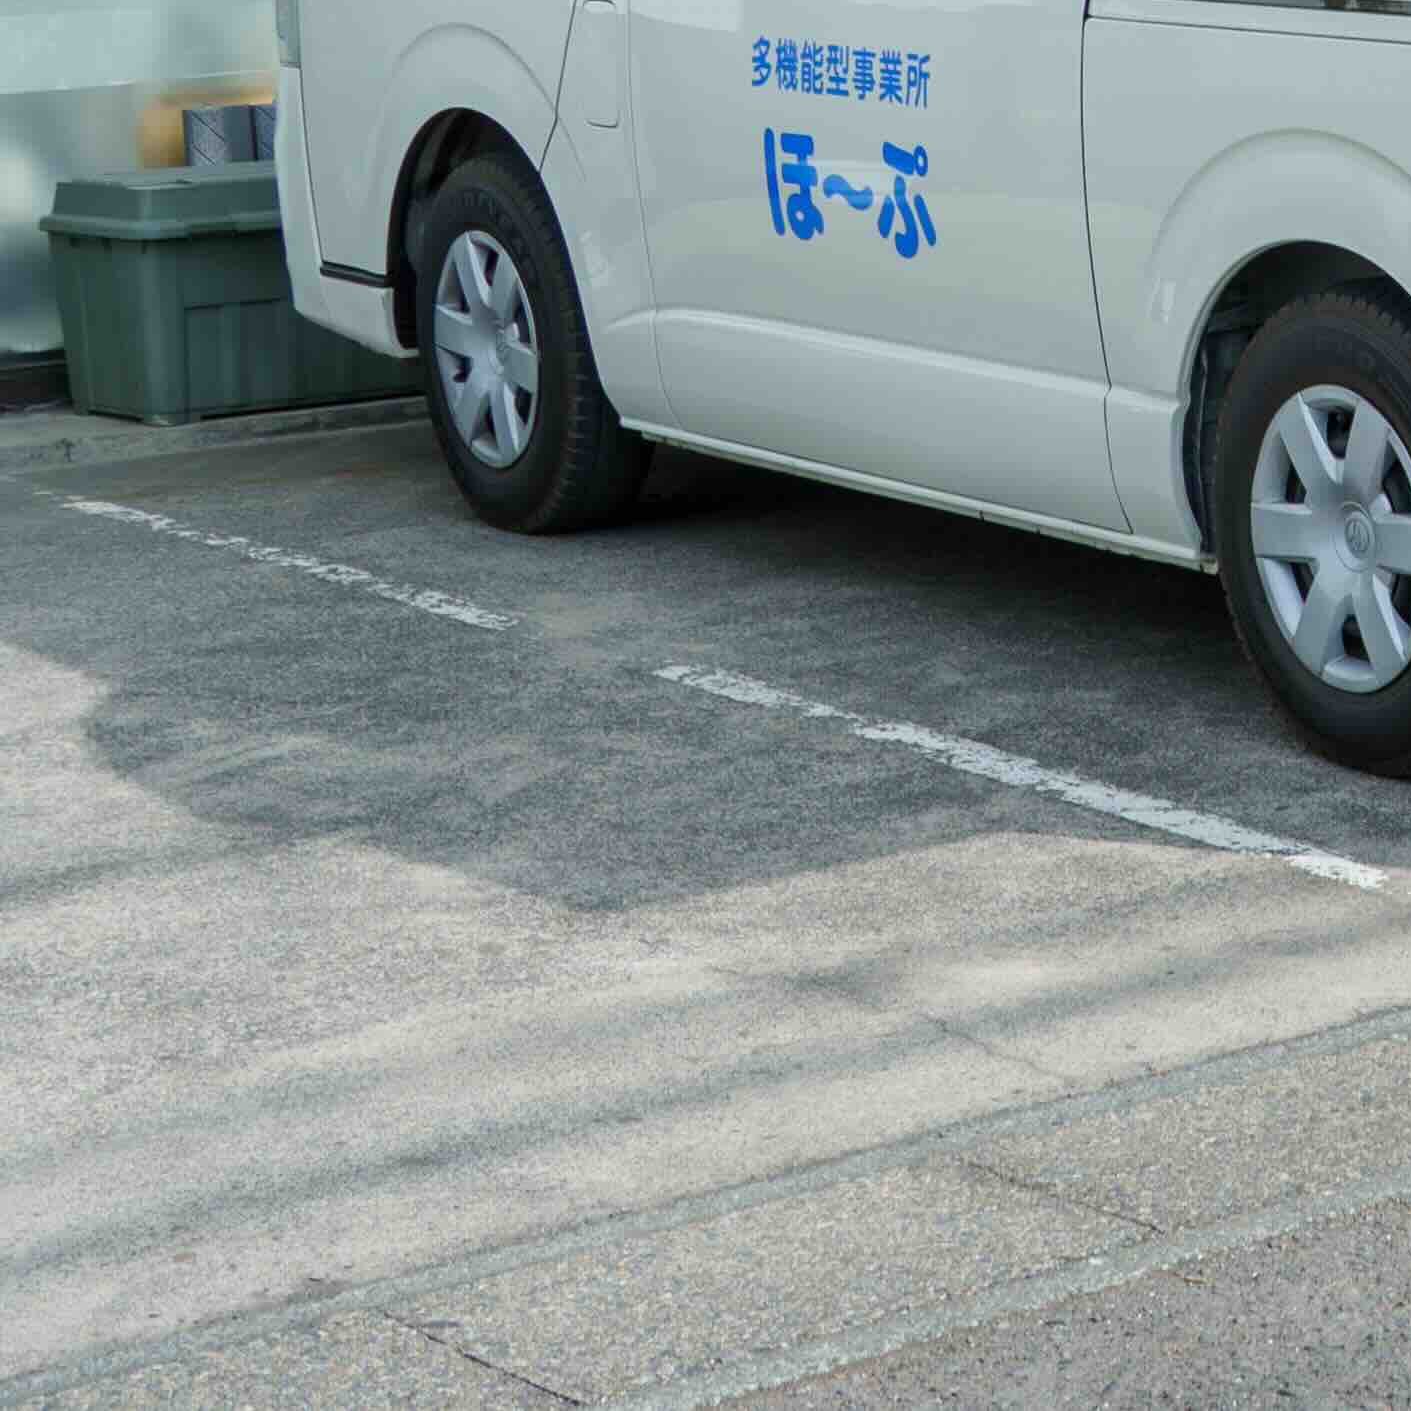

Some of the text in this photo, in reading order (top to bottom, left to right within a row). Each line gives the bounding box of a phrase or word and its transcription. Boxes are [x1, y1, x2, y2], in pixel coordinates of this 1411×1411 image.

[751, 35, 932, 109] 多機能型事業所
